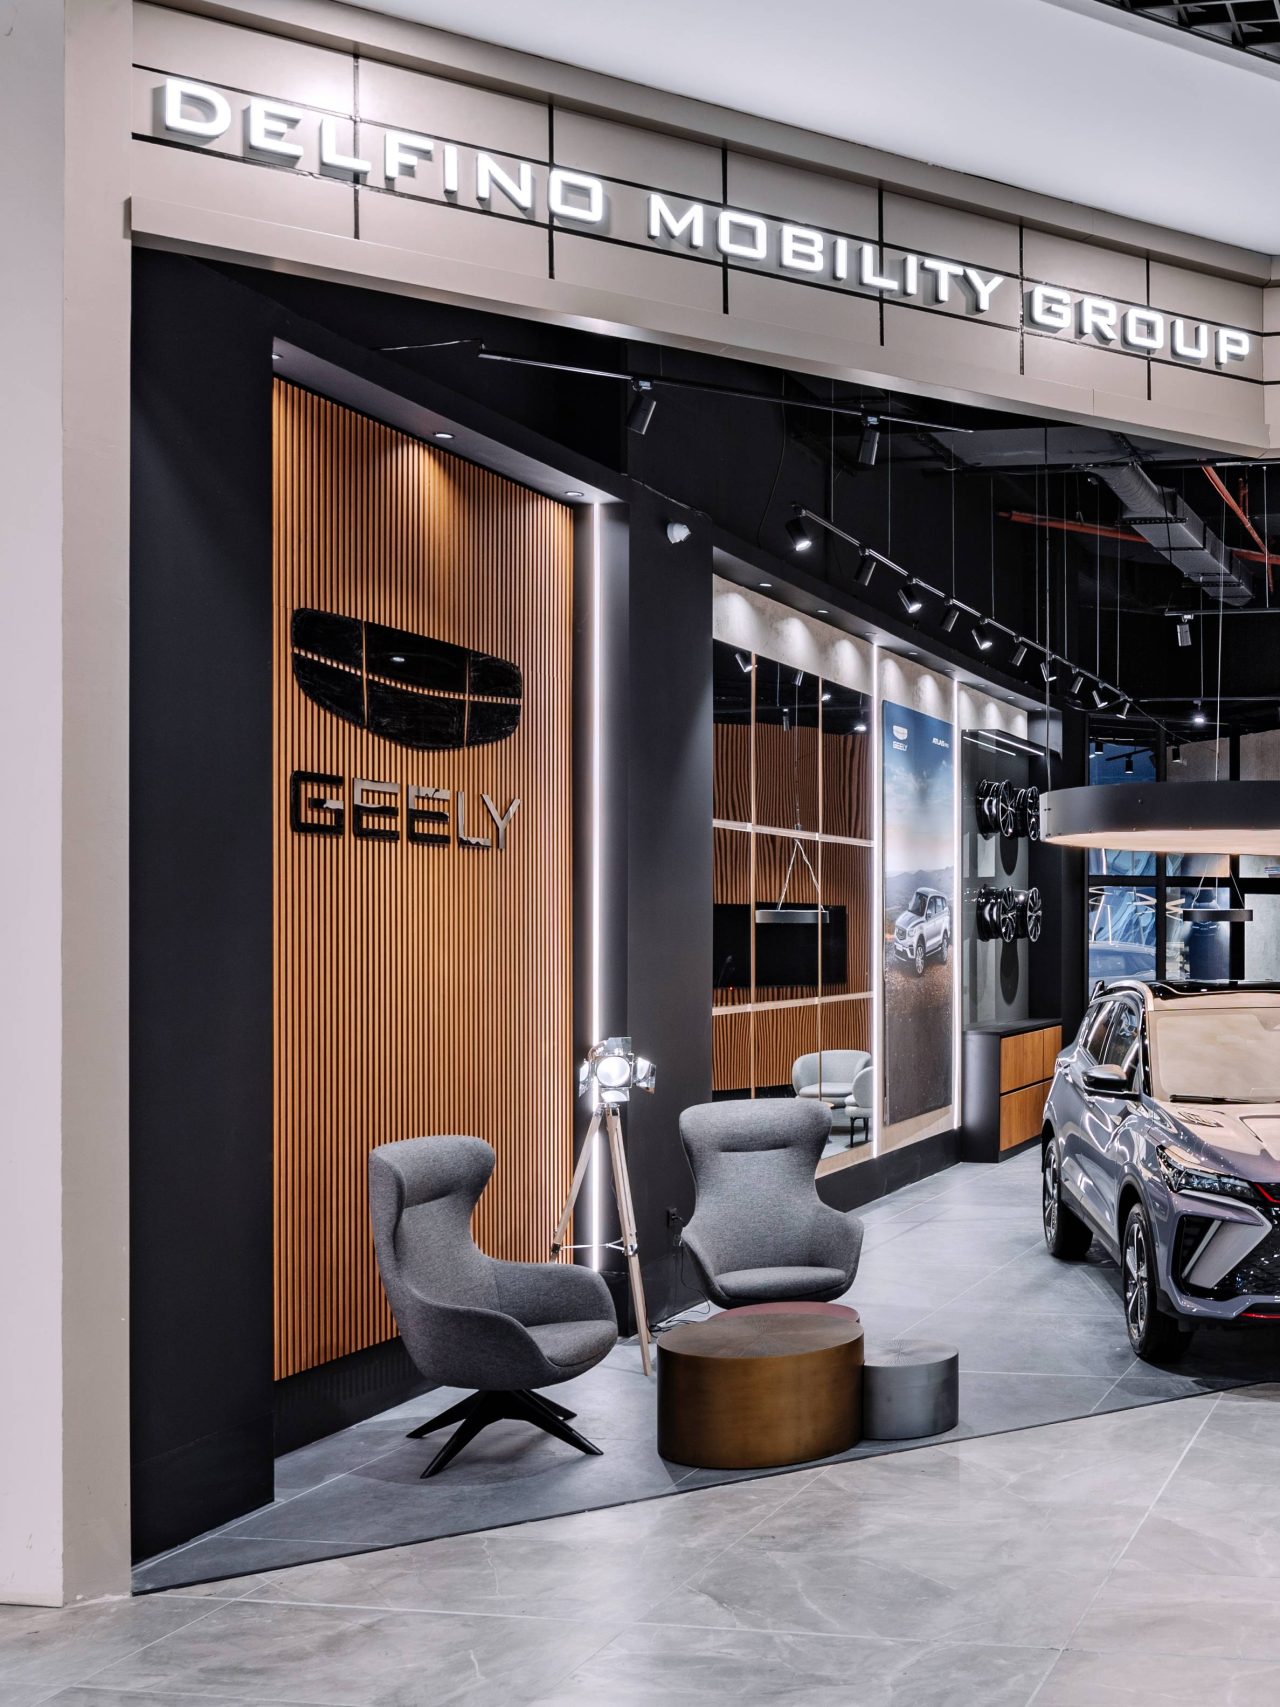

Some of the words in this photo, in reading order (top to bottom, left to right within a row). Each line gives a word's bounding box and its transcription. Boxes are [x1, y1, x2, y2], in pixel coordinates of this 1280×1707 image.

[162, 77, 604, 225] DELFINO
[647, 193, 1004, 313] MOBILITY
[1030, 283, 1251, 366] GROUP
[892, 740, 908, 752] GEELY
[291, 769, 522, 850] GEELY
